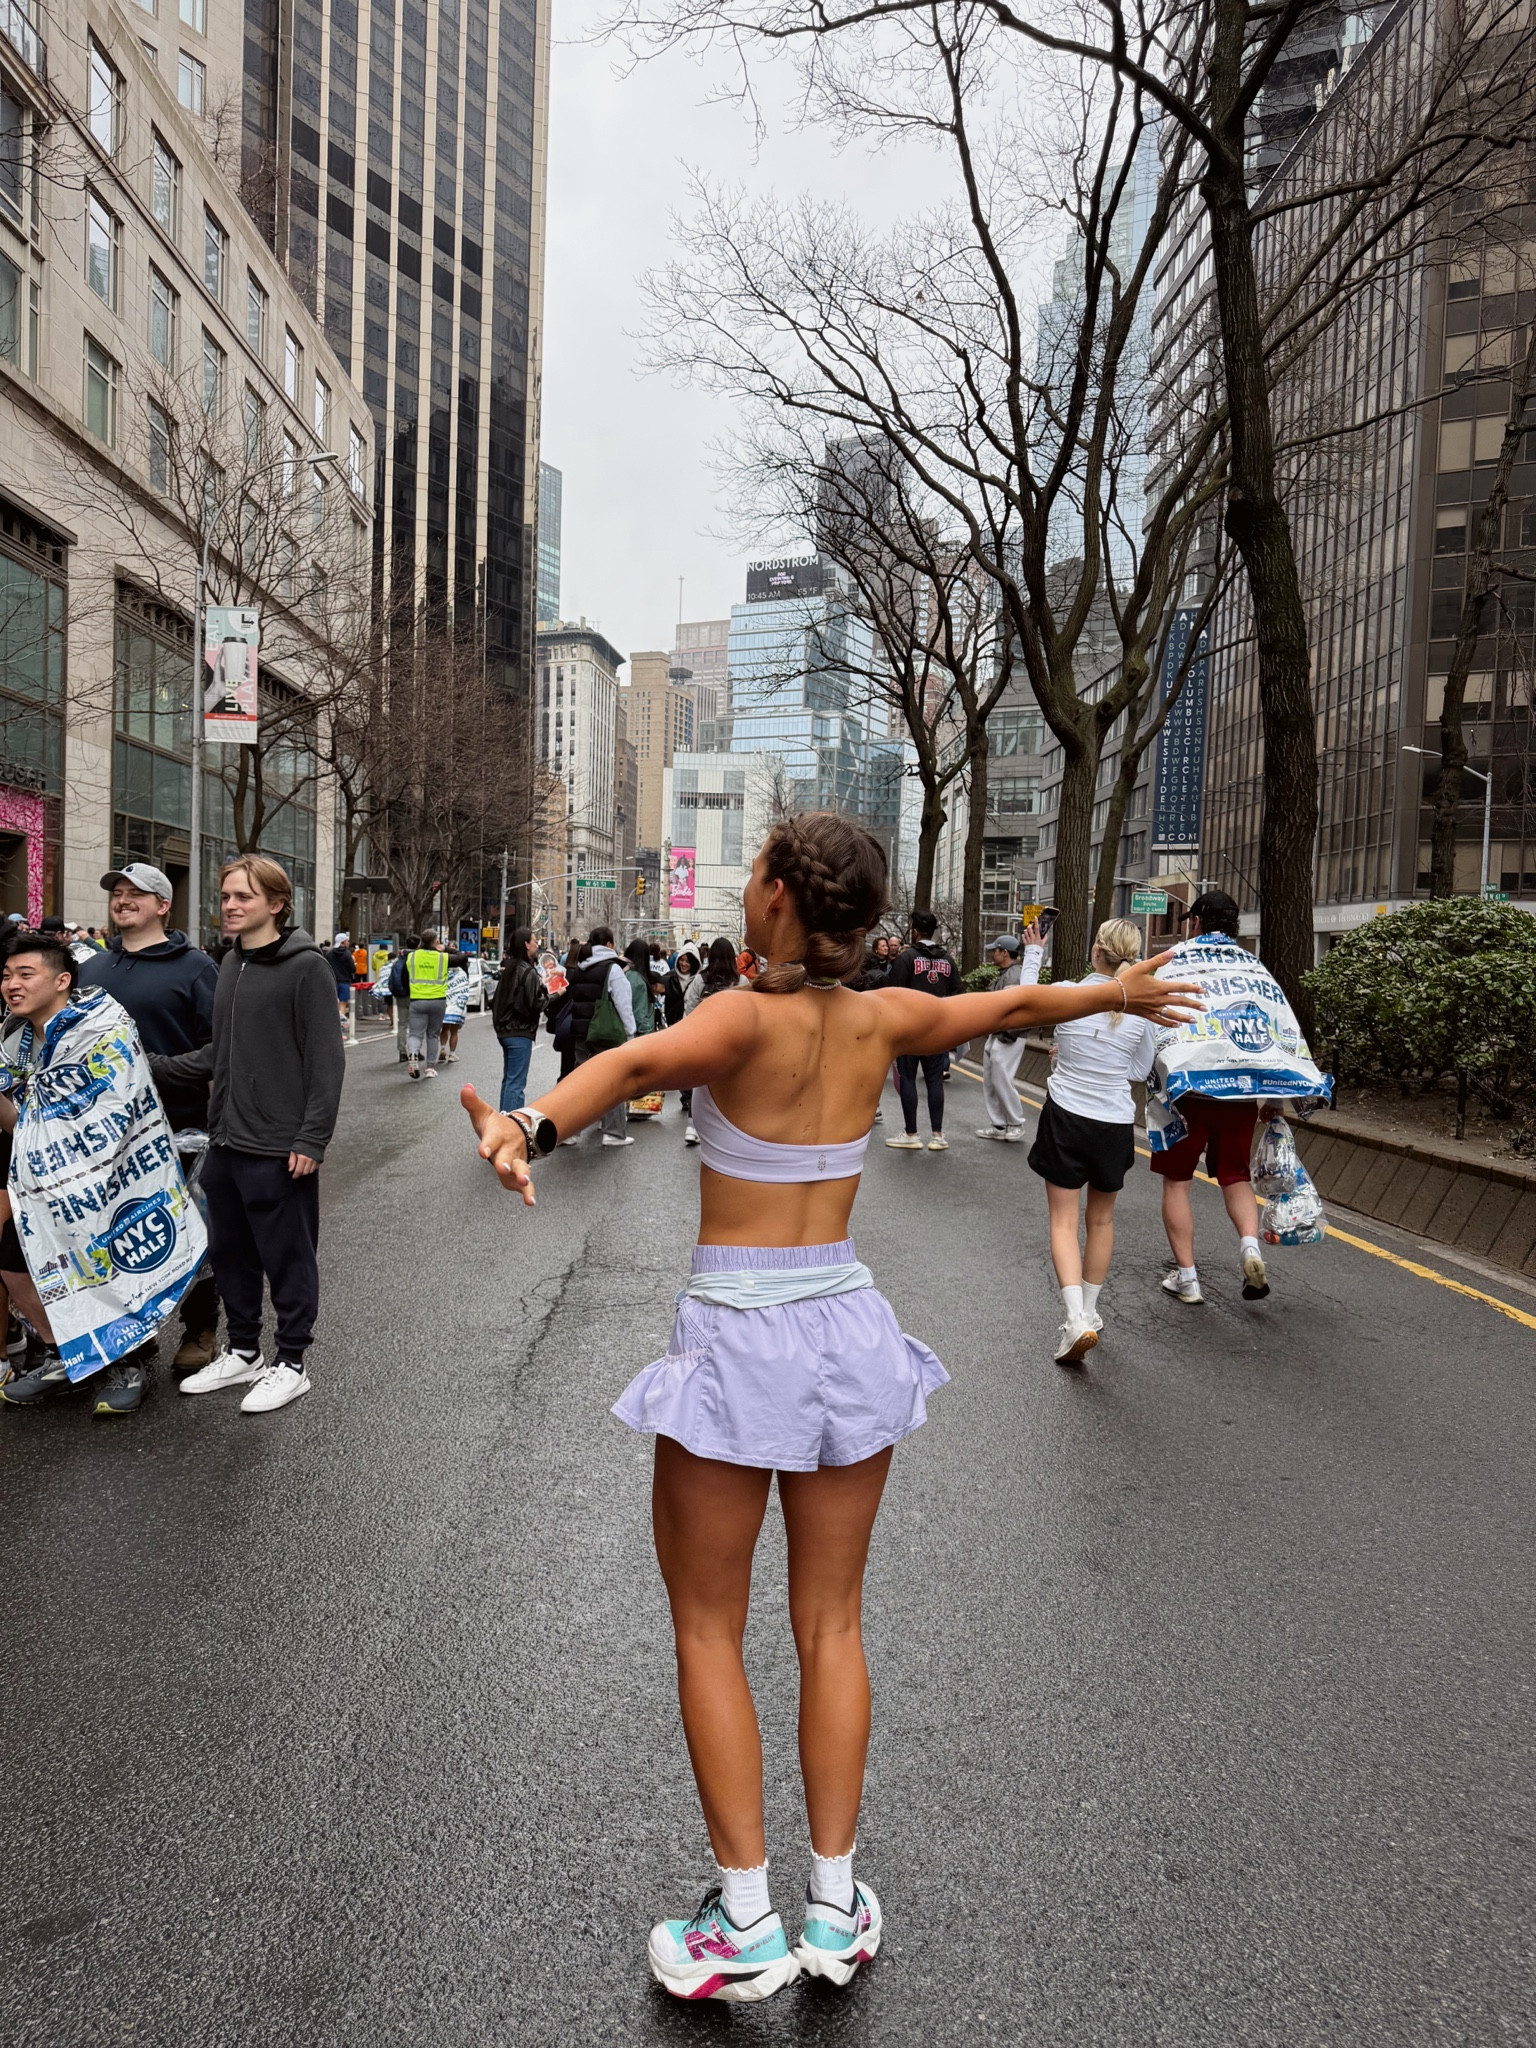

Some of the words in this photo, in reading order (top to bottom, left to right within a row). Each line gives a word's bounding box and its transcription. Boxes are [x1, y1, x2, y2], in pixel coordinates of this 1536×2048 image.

[747, 553, 819, 573] NORDSTROM
[748, 592, 767, 600] 10:45
[768, 590, 781, 598] AM
[670, 884, 694, 897] Barbie
[1135, 894, 1165, 902] Broadway
[914, 958, 931, 975] BIG
[931, 960, 951, 978] RED
[1228, 1017, 1267, 1034] NYC
[1234, 1032, 1268, 1044] HALF
[1204, 1077, 1235, 1085] UNITED
[48, 1132, 176, 1228] FINISHER
[101, 1223, 126, 1245] UNITED
[129, 1196, 162, 1220] AIRLINES
[113, 1211, 165, 1257] NYC
[125, 1231, 167, 1268] HALF
